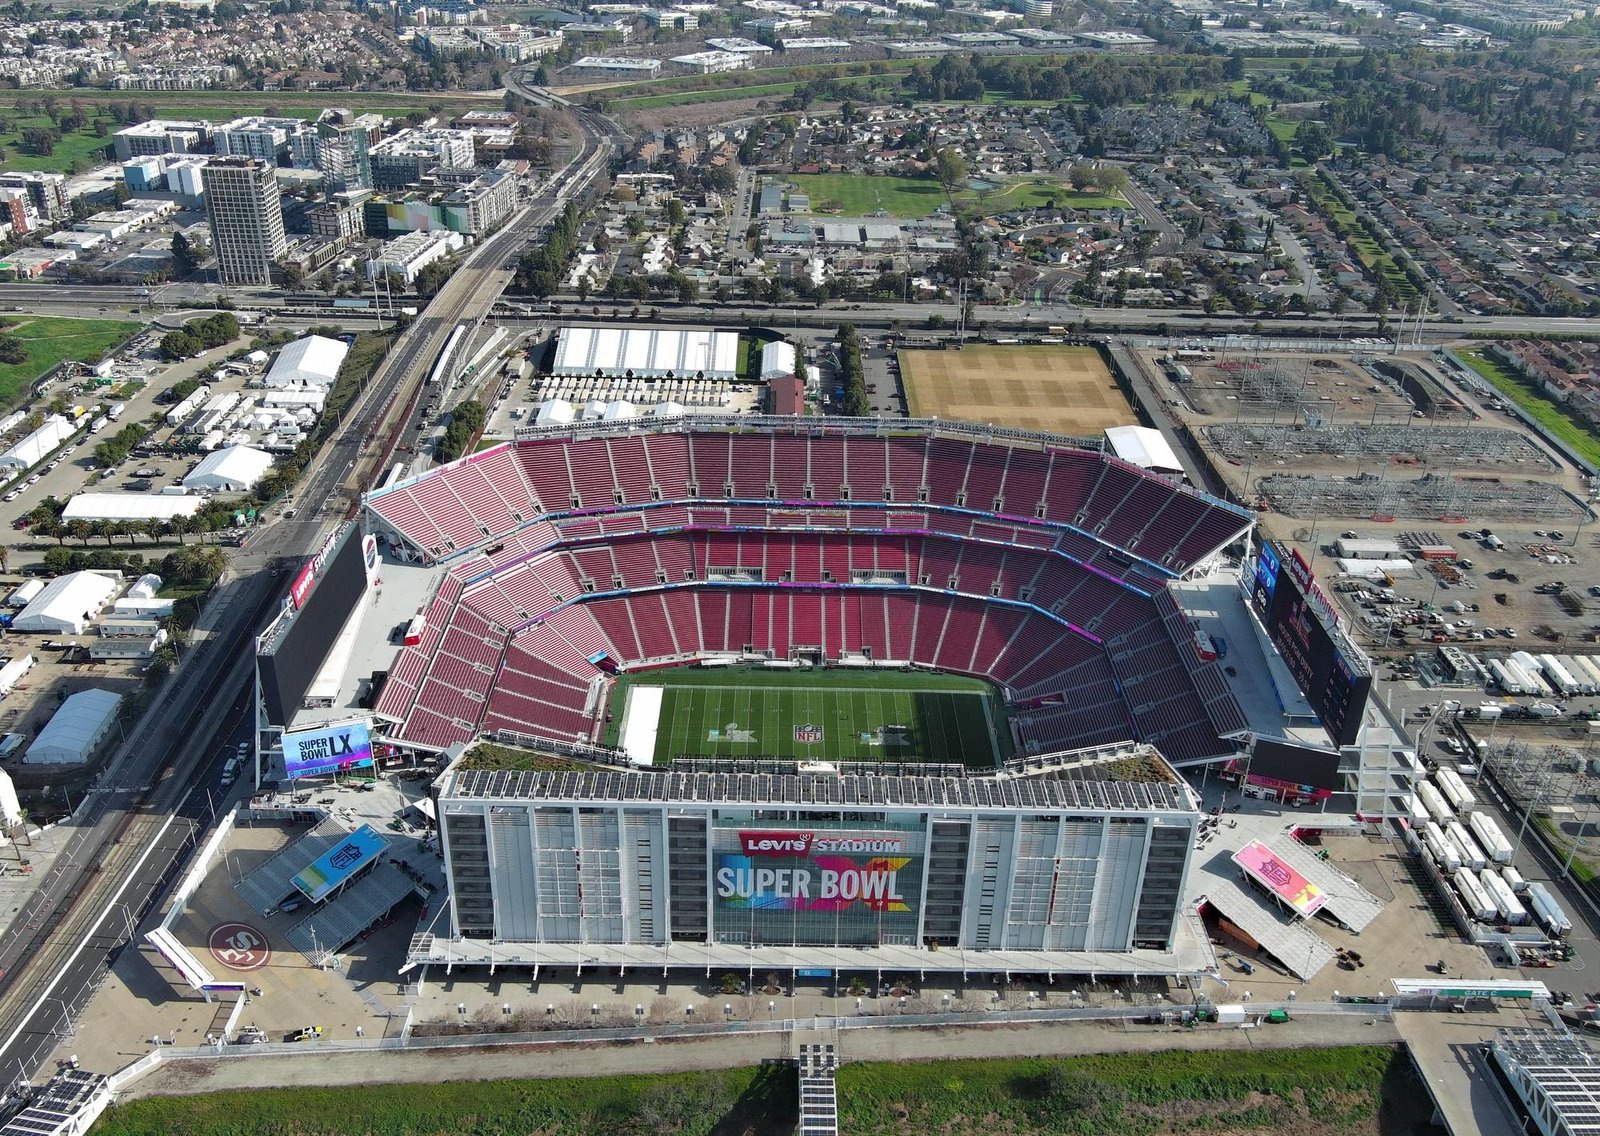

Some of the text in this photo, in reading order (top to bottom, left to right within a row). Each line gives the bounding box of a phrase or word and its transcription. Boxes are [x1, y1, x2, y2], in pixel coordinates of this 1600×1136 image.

[797, 733, 820, 741] NFL
[299, 738, 327, 751] SUPER
[329, 733, 353, 756] LX
[301, 747, 330, 761] BOWL
[300, 767, 320, 776] SUPER
[320, 764, 337, 774] BOWL
[817, 840, 900, 853] STADIUM
[332, 851, 351, 870] NFL
[717, 867, 904, 900] SUPER BOWL
[1269, 868, 1289, 885] NFL
